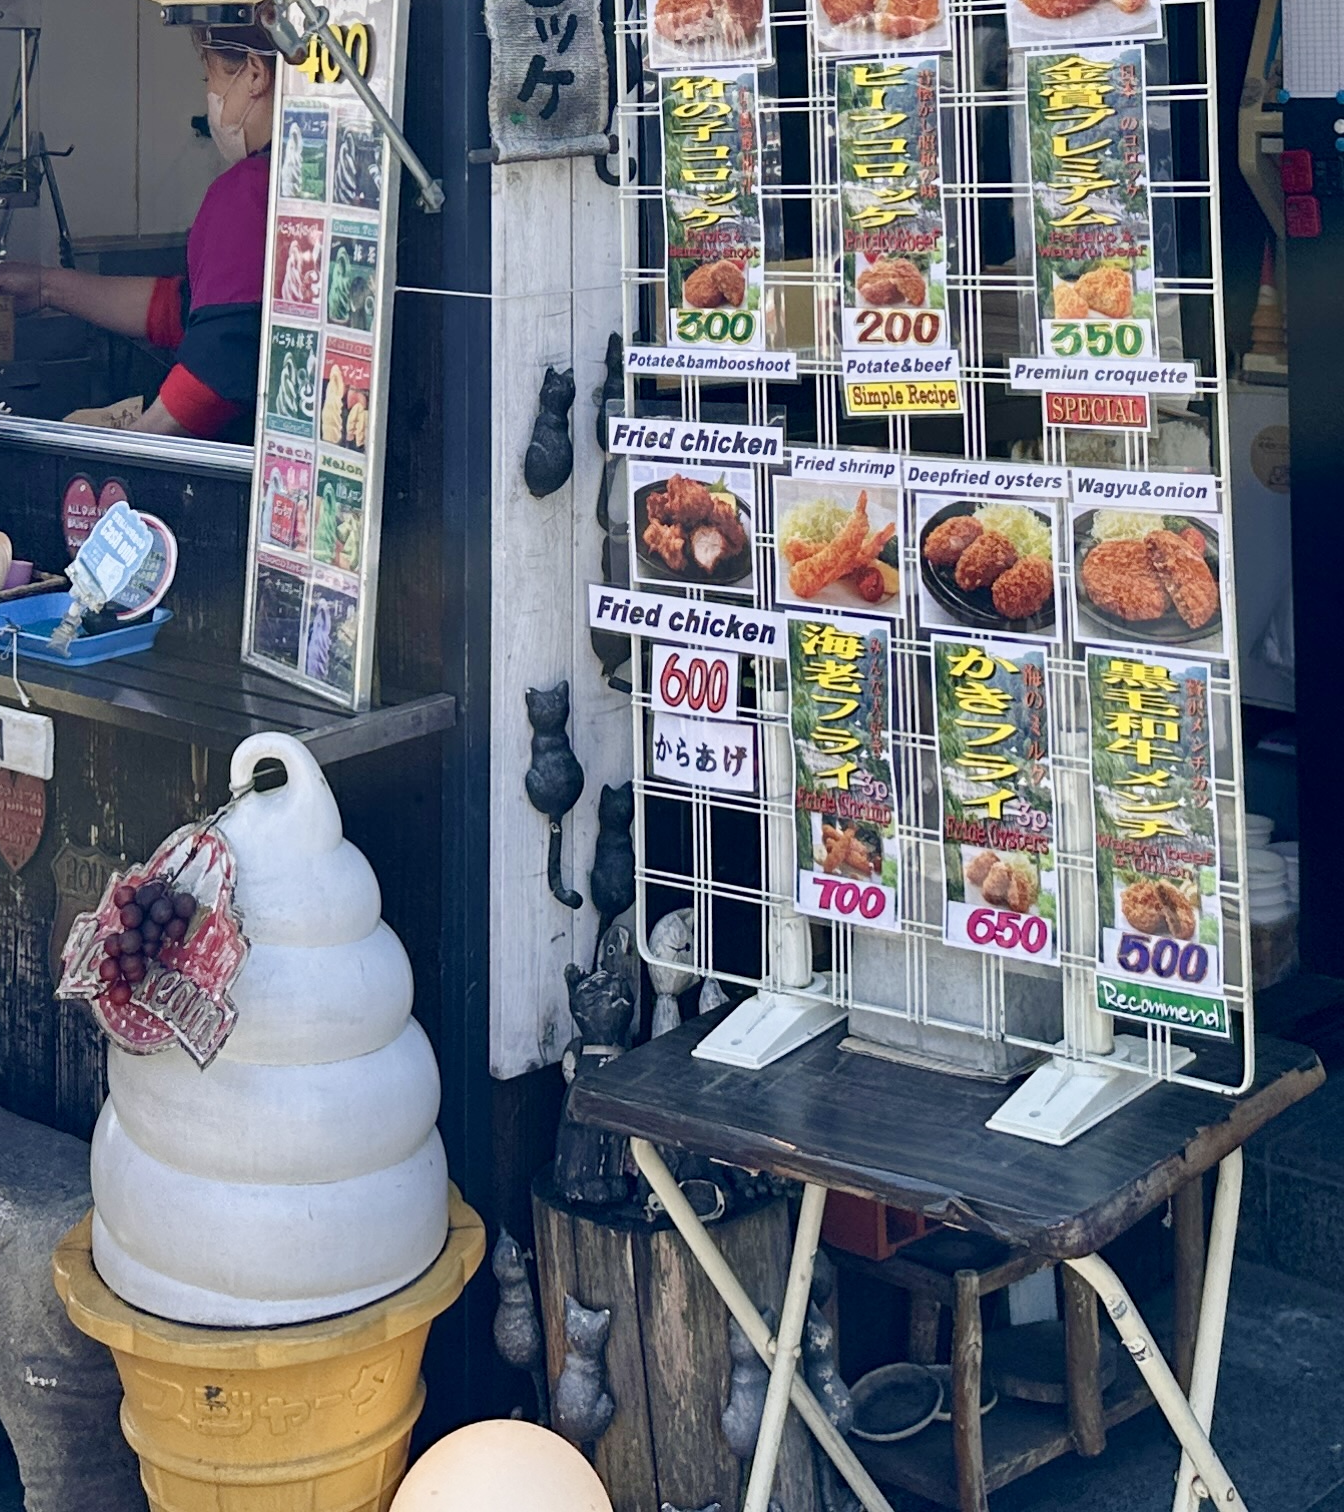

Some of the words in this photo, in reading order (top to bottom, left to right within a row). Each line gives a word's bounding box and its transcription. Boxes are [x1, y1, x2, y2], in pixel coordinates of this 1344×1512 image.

[670, 76, 739, 229] 竹の子コロッケ
[850, 63, 918, 229] ビーフコロッケ
[1039, 55, 1120, 228] 金賞プレミアム
[676, 310, 755, 344] 300
[855, 310, 941, 345] 200
[1050, 321, 1145, 358] 350
[626, 351, 791, 374] Potate&bambooshoot
[845, 356, 953, 376] Potate&beef
[1014, 362, 1090, 384] Premiun
[1094, 365, 1189, 385] croquette
[851, 385, 904, 408] Simple
[906, 385, 957, 408] Recipe
[1052, 397, 1143, 424] SPECIAL
[266, 440, 313, 460] Peach
[612, 424, 674, 451] Fried
[679, 428, 778, 459] chicken
[321, 454, 364, 477] Melon
[794, 455, 838, 472] Fried
[840, 457, 896, 478] shrimp
[907, 467, 990, 491] Deepfried
[994, 471, 1062, 494] oysters
[1077, 478, 1208, 502] Wagyu&onion
[100, 520, 123, 550] Cash
[596, 595, 663, 628] Fried
[668, 605, 776, 645] chicken
[660, 652, 728, 714] 600
[801, 623, 866, 791] 海老フライ
[1021, 663, 1045, 787] 海のミルク
[947, 646, 1021, 820] かきフライ
[1102, 659, 1186, 840] 黒毛和牛メンチ
[653, 731, 749, 777] からあげ
[860, 768, 889, 801] 3p
[1015, 802, 1048, 834] 3p
[812, 877, 886, 920] 700
[966, 907, 1048, 954] 650
[1117, 931, 1209, 983] 500
[1099, 979, 1220, 1031] Recommend
[135, 1348, 404, 1437] スジャータ
